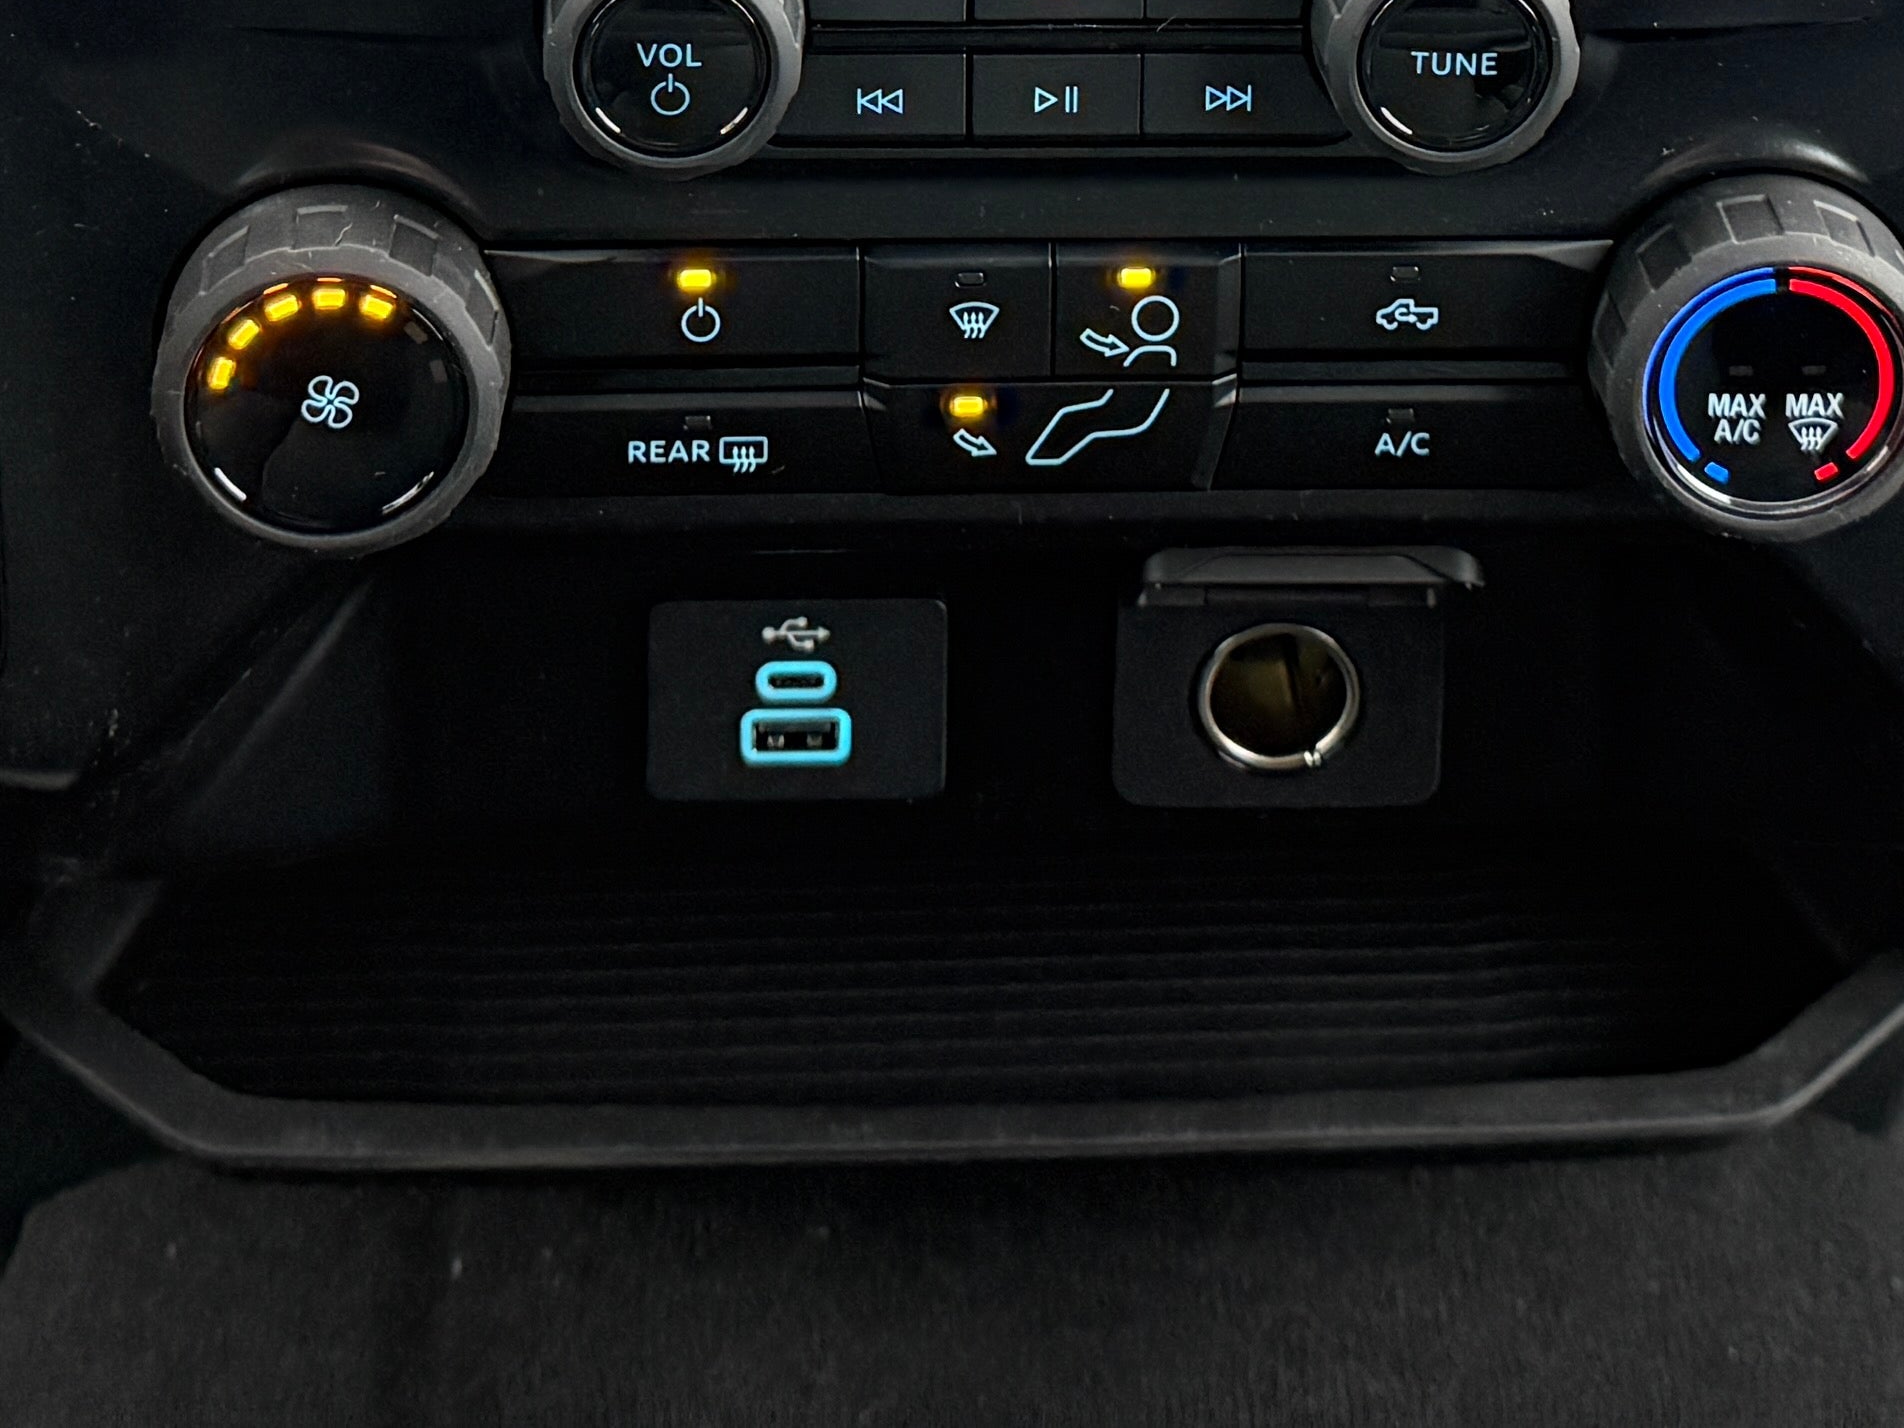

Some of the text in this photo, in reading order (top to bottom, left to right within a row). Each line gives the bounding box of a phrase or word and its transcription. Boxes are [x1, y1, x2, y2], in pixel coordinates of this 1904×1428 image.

[636, 42, 703, 69] VOL
[1410, 50, 1499, 77] TUNE
[1707, 391, 1844, 420] MAX MAX
[1374, 430, 1431, 458] A/C
[1712, 419, 1761, 445] A/C
[626, 438, 711, 464] REAR
